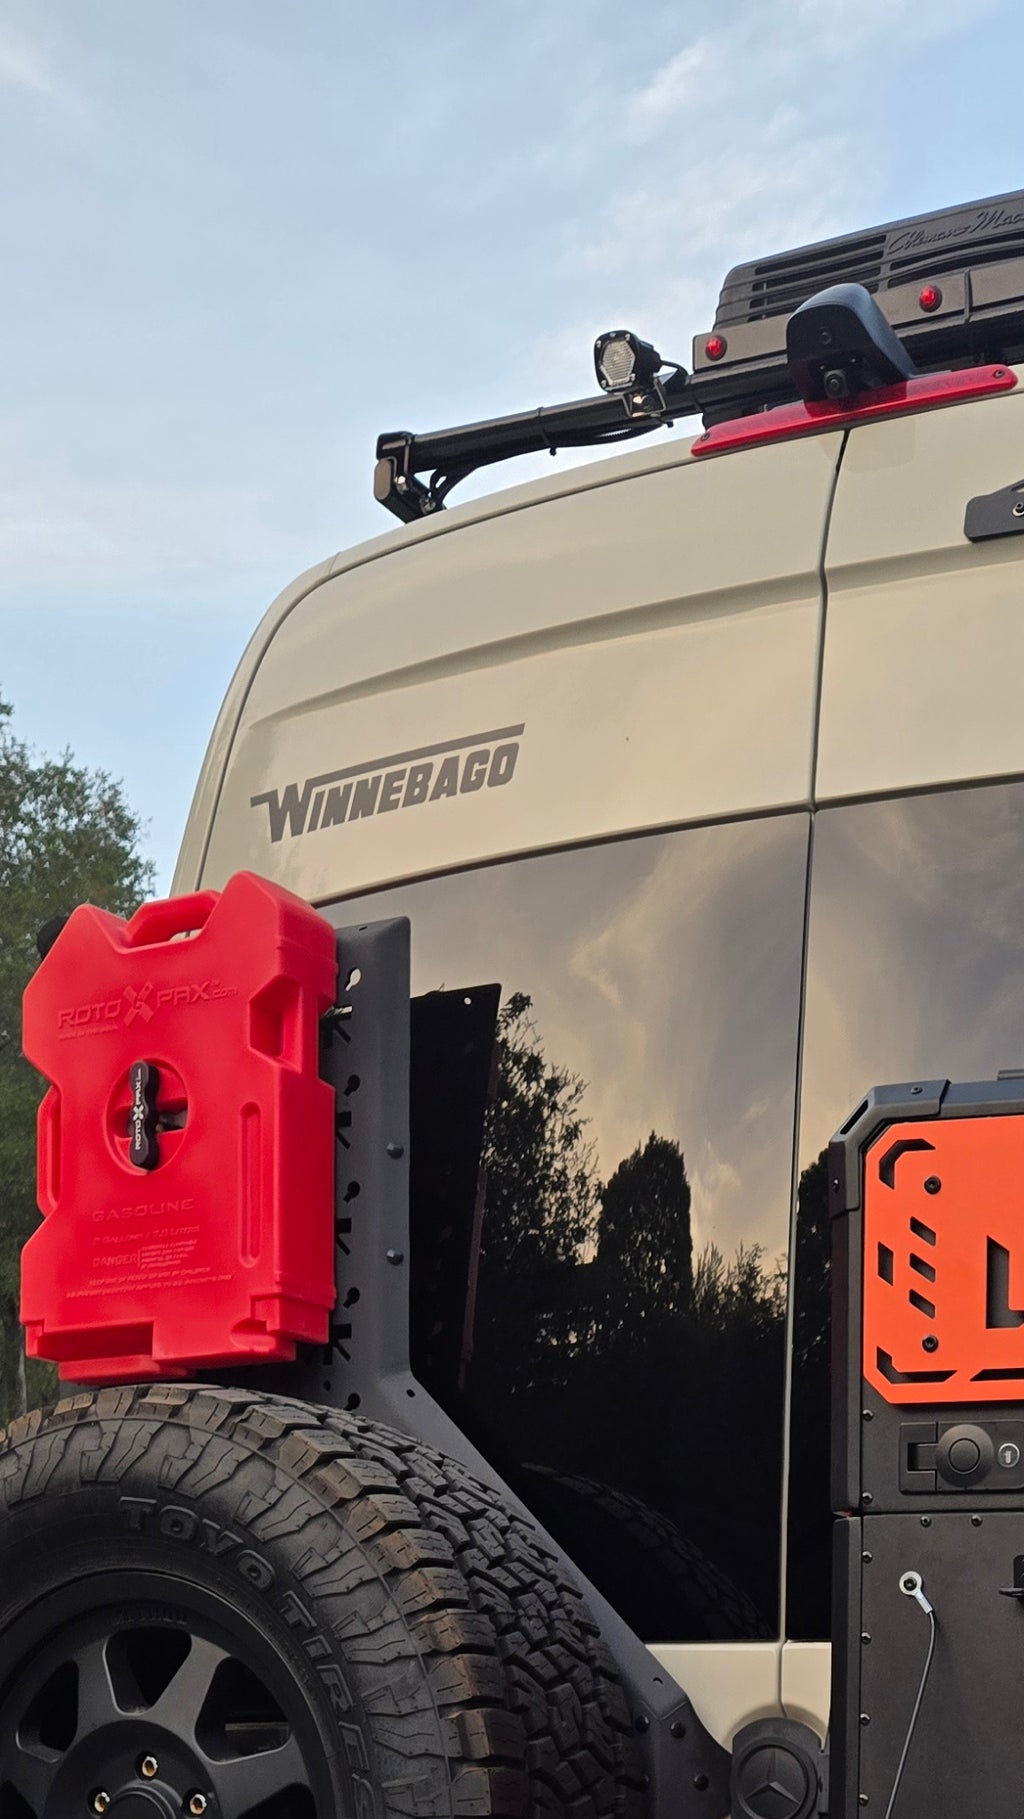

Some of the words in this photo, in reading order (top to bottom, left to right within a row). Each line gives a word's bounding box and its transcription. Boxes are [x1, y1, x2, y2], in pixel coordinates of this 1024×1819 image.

[250, 723, 525, 843] WINNEBAGO
[92, 1198, 194, 1221] GASOLINE
[92, 1253, 138, 1268] DANGER
[118, 1496, 276, 1591] TOYO
